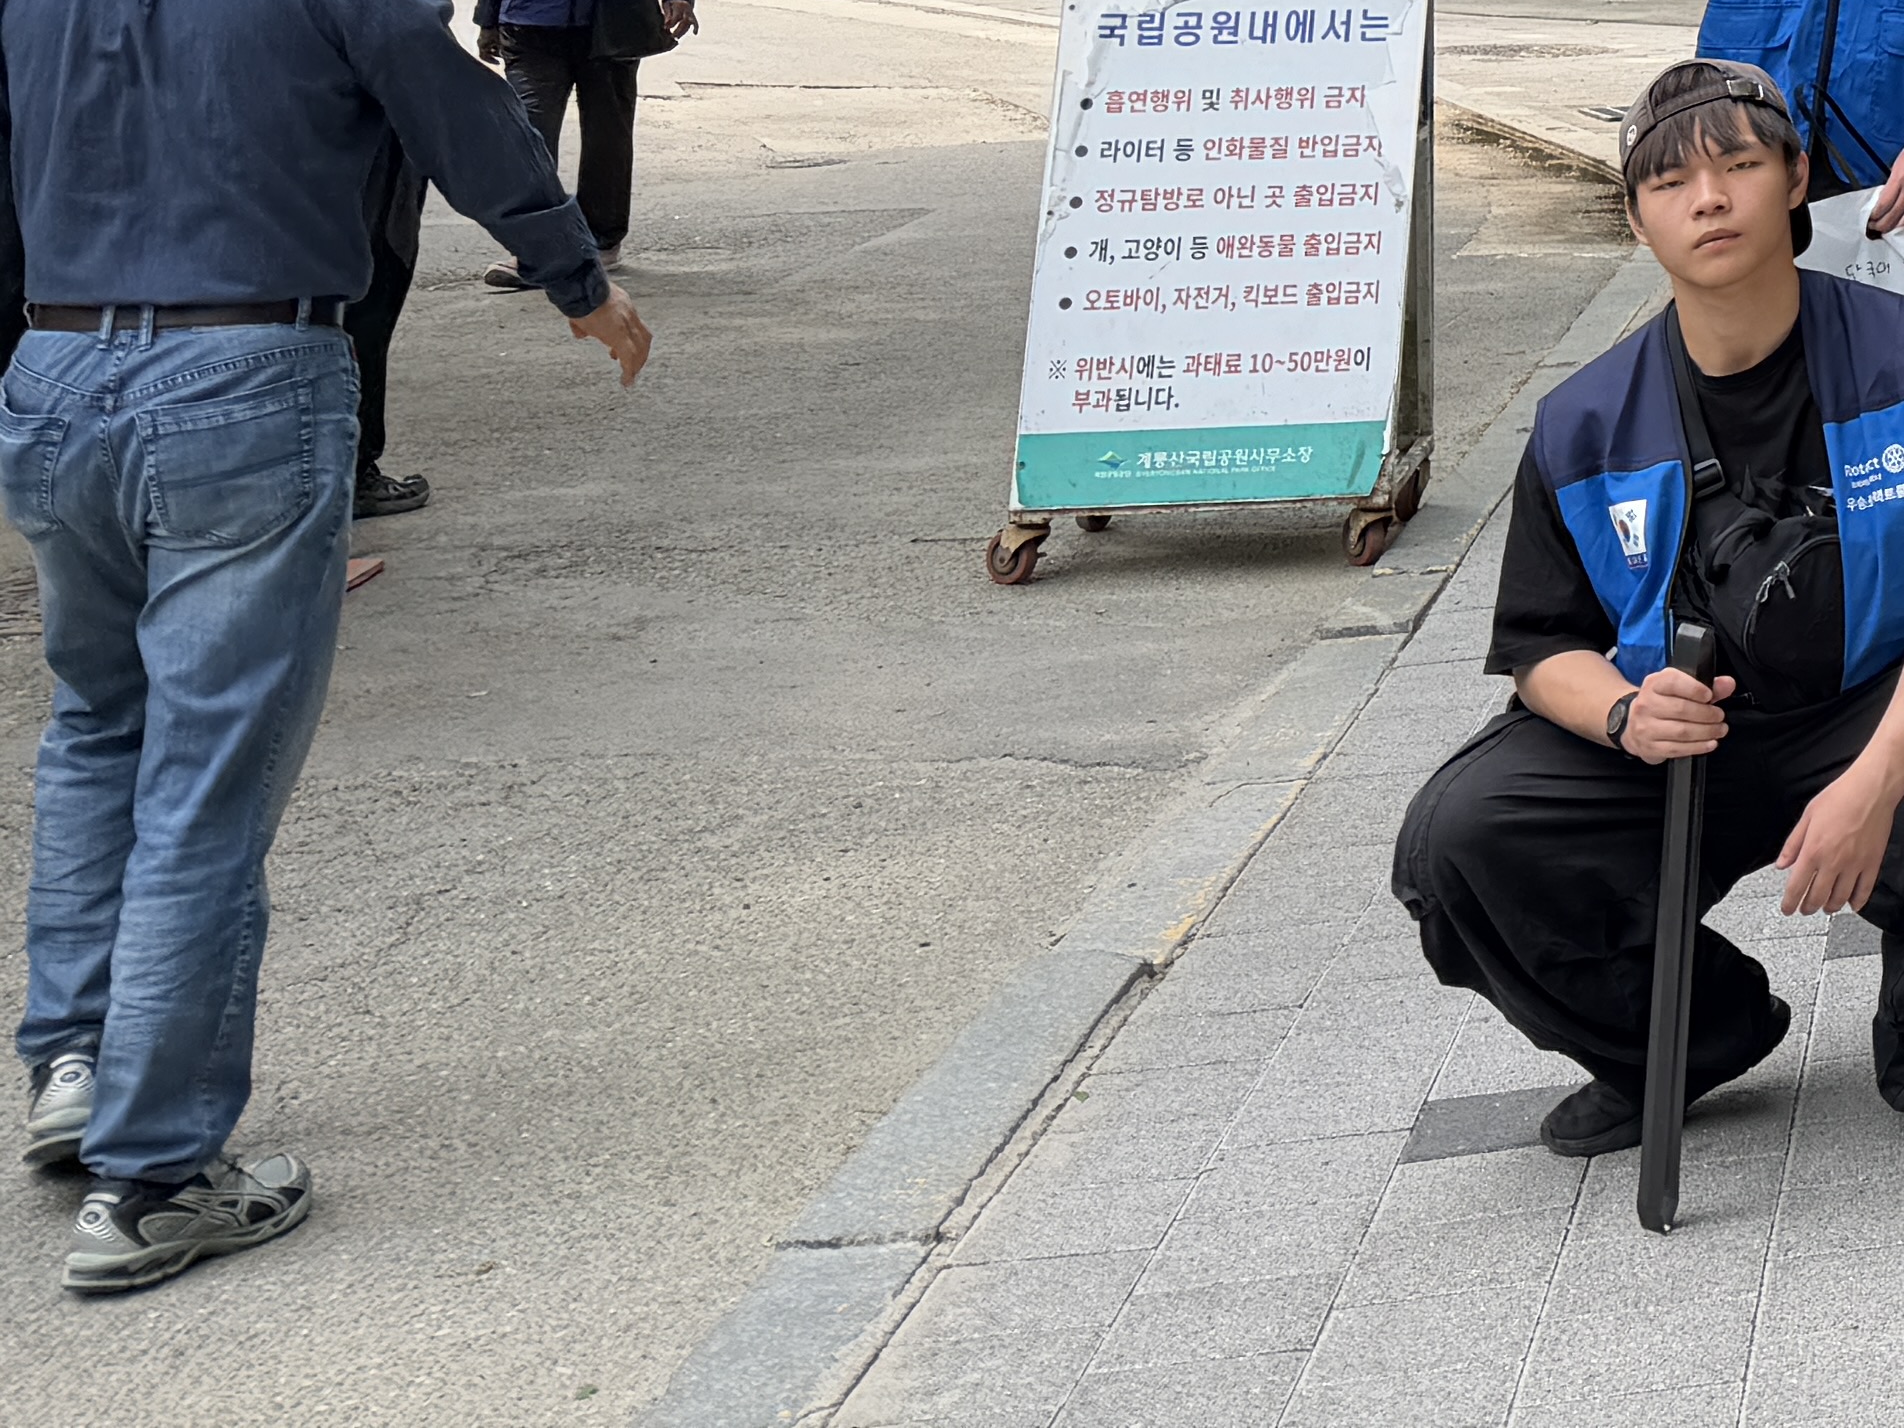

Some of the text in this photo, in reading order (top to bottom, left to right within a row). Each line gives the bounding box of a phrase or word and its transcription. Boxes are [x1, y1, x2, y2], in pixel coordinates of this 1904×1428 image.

[1097, 8, 1389, 47] 국립공원내에서는
[1105, 84, 1366, 114] 흡연행위 및 취사행위 금지
[1100, 134, 1383, 163] 라이터 등 인화물질 반입금지
[1094, 182, 1379, 213] 정규탐방로 아닌 곳 출입금지
[1088, 230, 1382, 265] 개, 고양이 등 애완동물 출입금지
[1083, 279, 1380, 314] 오토바이, 자전거, 킥보드 출입금지
[1074, 346, 1371, 382] 위반시에는 과태료 10~50만원이
[1071, 385, 1180, 414] 부과됩니다.
